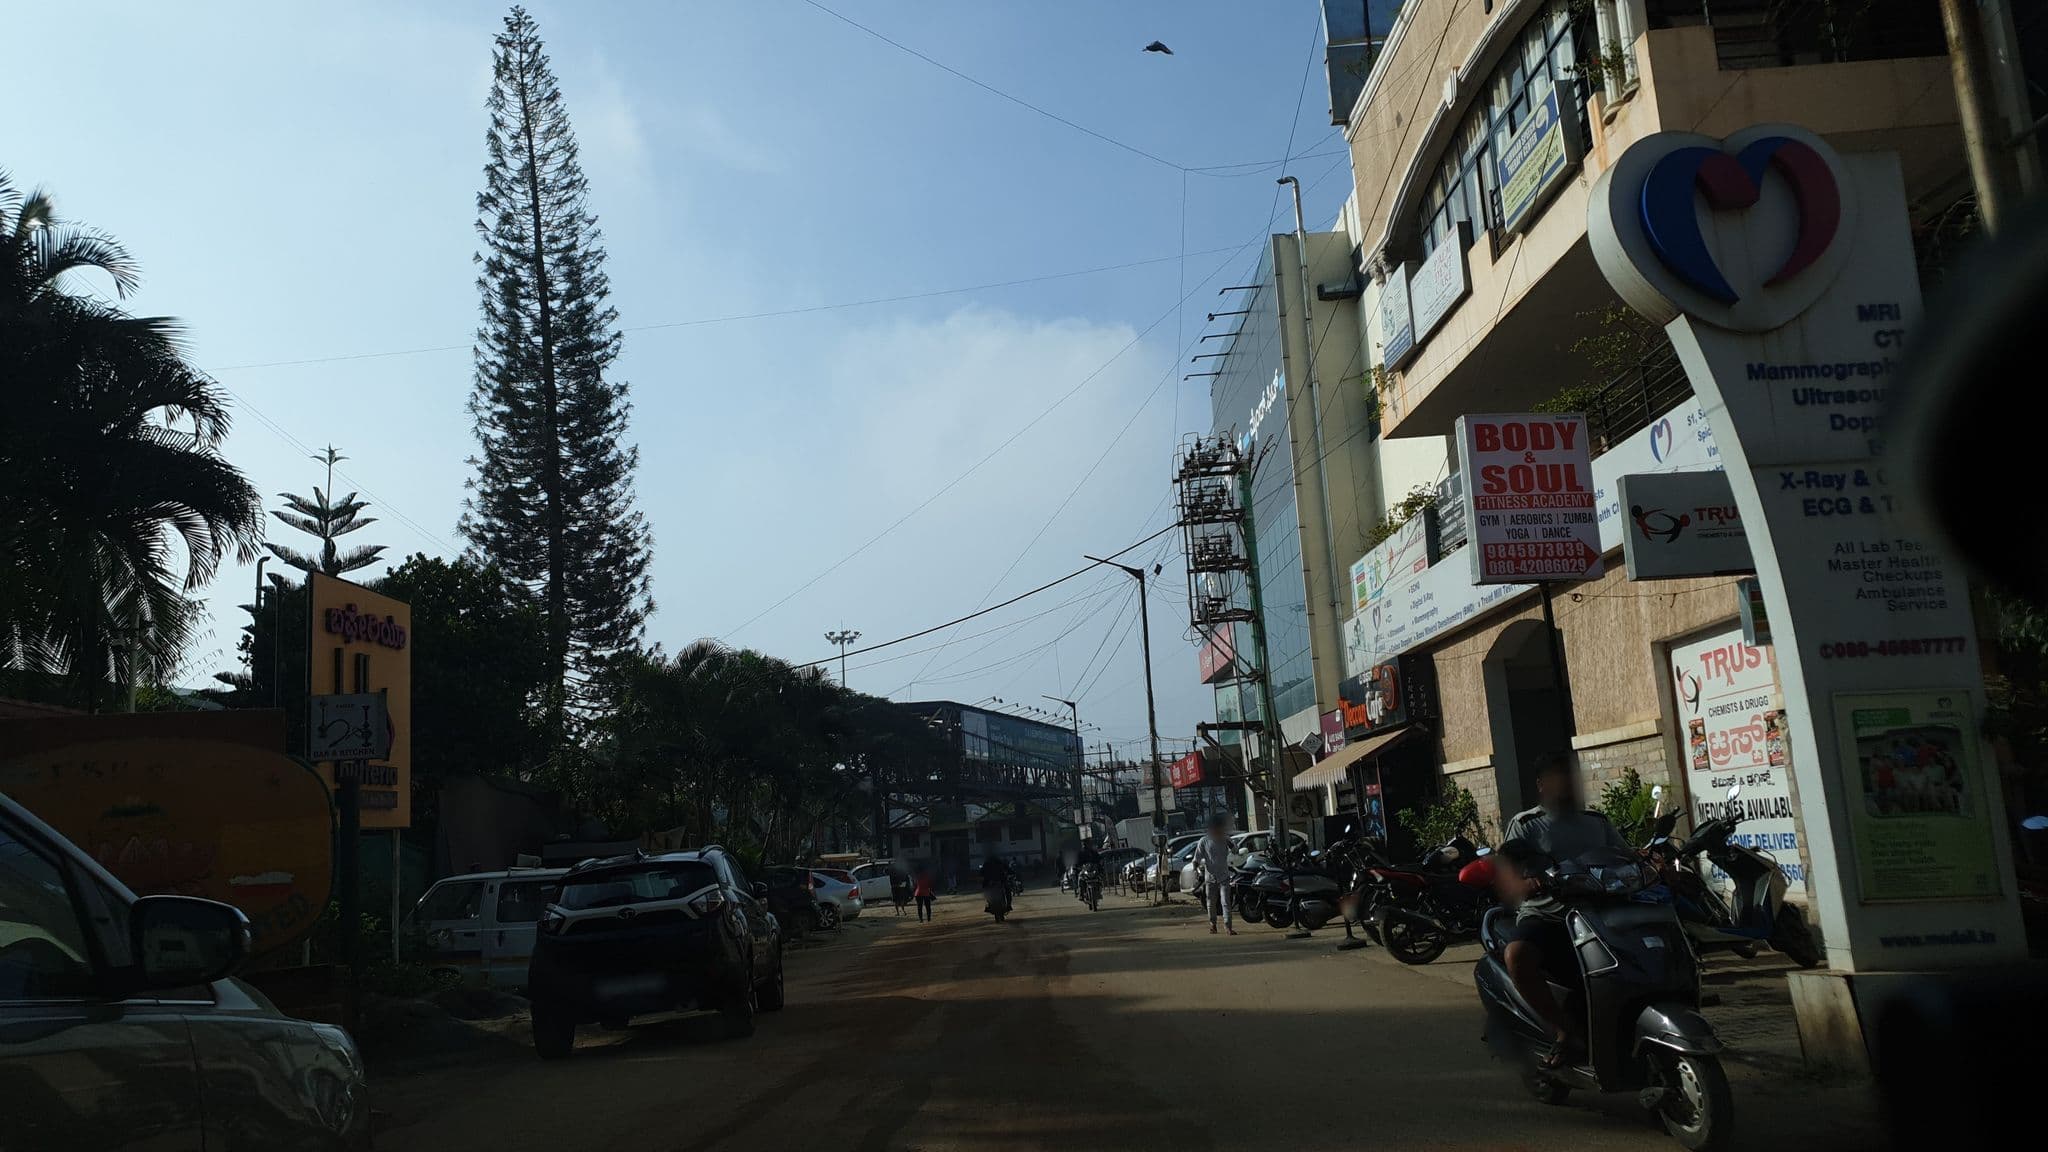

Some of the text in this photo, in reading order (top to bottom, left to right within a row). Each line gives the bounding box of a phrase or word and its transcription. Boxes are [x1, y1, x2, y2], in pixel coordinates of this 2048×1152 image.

[1857, 304, 1900, 321] MRI
[1874, 329, 1904, 348] CT
[1746, 359, 1900, 381] Mammograph
[1792, 388, 1888, 405] Ultrasou
[1474, 422, 1578, 452] BODY
[1697, 427, 1712, 443] Spic
[1525, 451, 1536, 463] &
[1482, 464, 1584, 494] SOUL
[1779, 470, 1847, 490] X-Ray
[1853, 469, 1871, 487] &
[1479, 494, 1589, 508] FITNESS ACADEMY
[1802, 497, 1852, 517] ECG
[1859, 496, 1876, 514] &
[1480, 512, 1594, 526] GYM AEROBICS ZUMBA
[1598, 503, 1611, 523] alth
[1695, 506, 1738, 526] TRU
[1505, 527, 1572, 539] YOGA DANCE
[1487, 542, 1585, 558] 9845873839
[1833, 542, 1856, 554] All
[1861, 540, 1890, 553] Lab
[1828, 558, 1882, 572] Master
[1863, 570, 1943, 584] Checkups
[1856, 586, 1945, 600] Ambulance
[1887, 599, 1948, 611] Service
[1700, 641, 1771, 683] TRUS
[1708, 695, 1769, 718] CHEMISTS & DRUGG
[1747, 797, 1793, 820] AVAILABL
[1755, 834, 1797, 850] DELIVER
